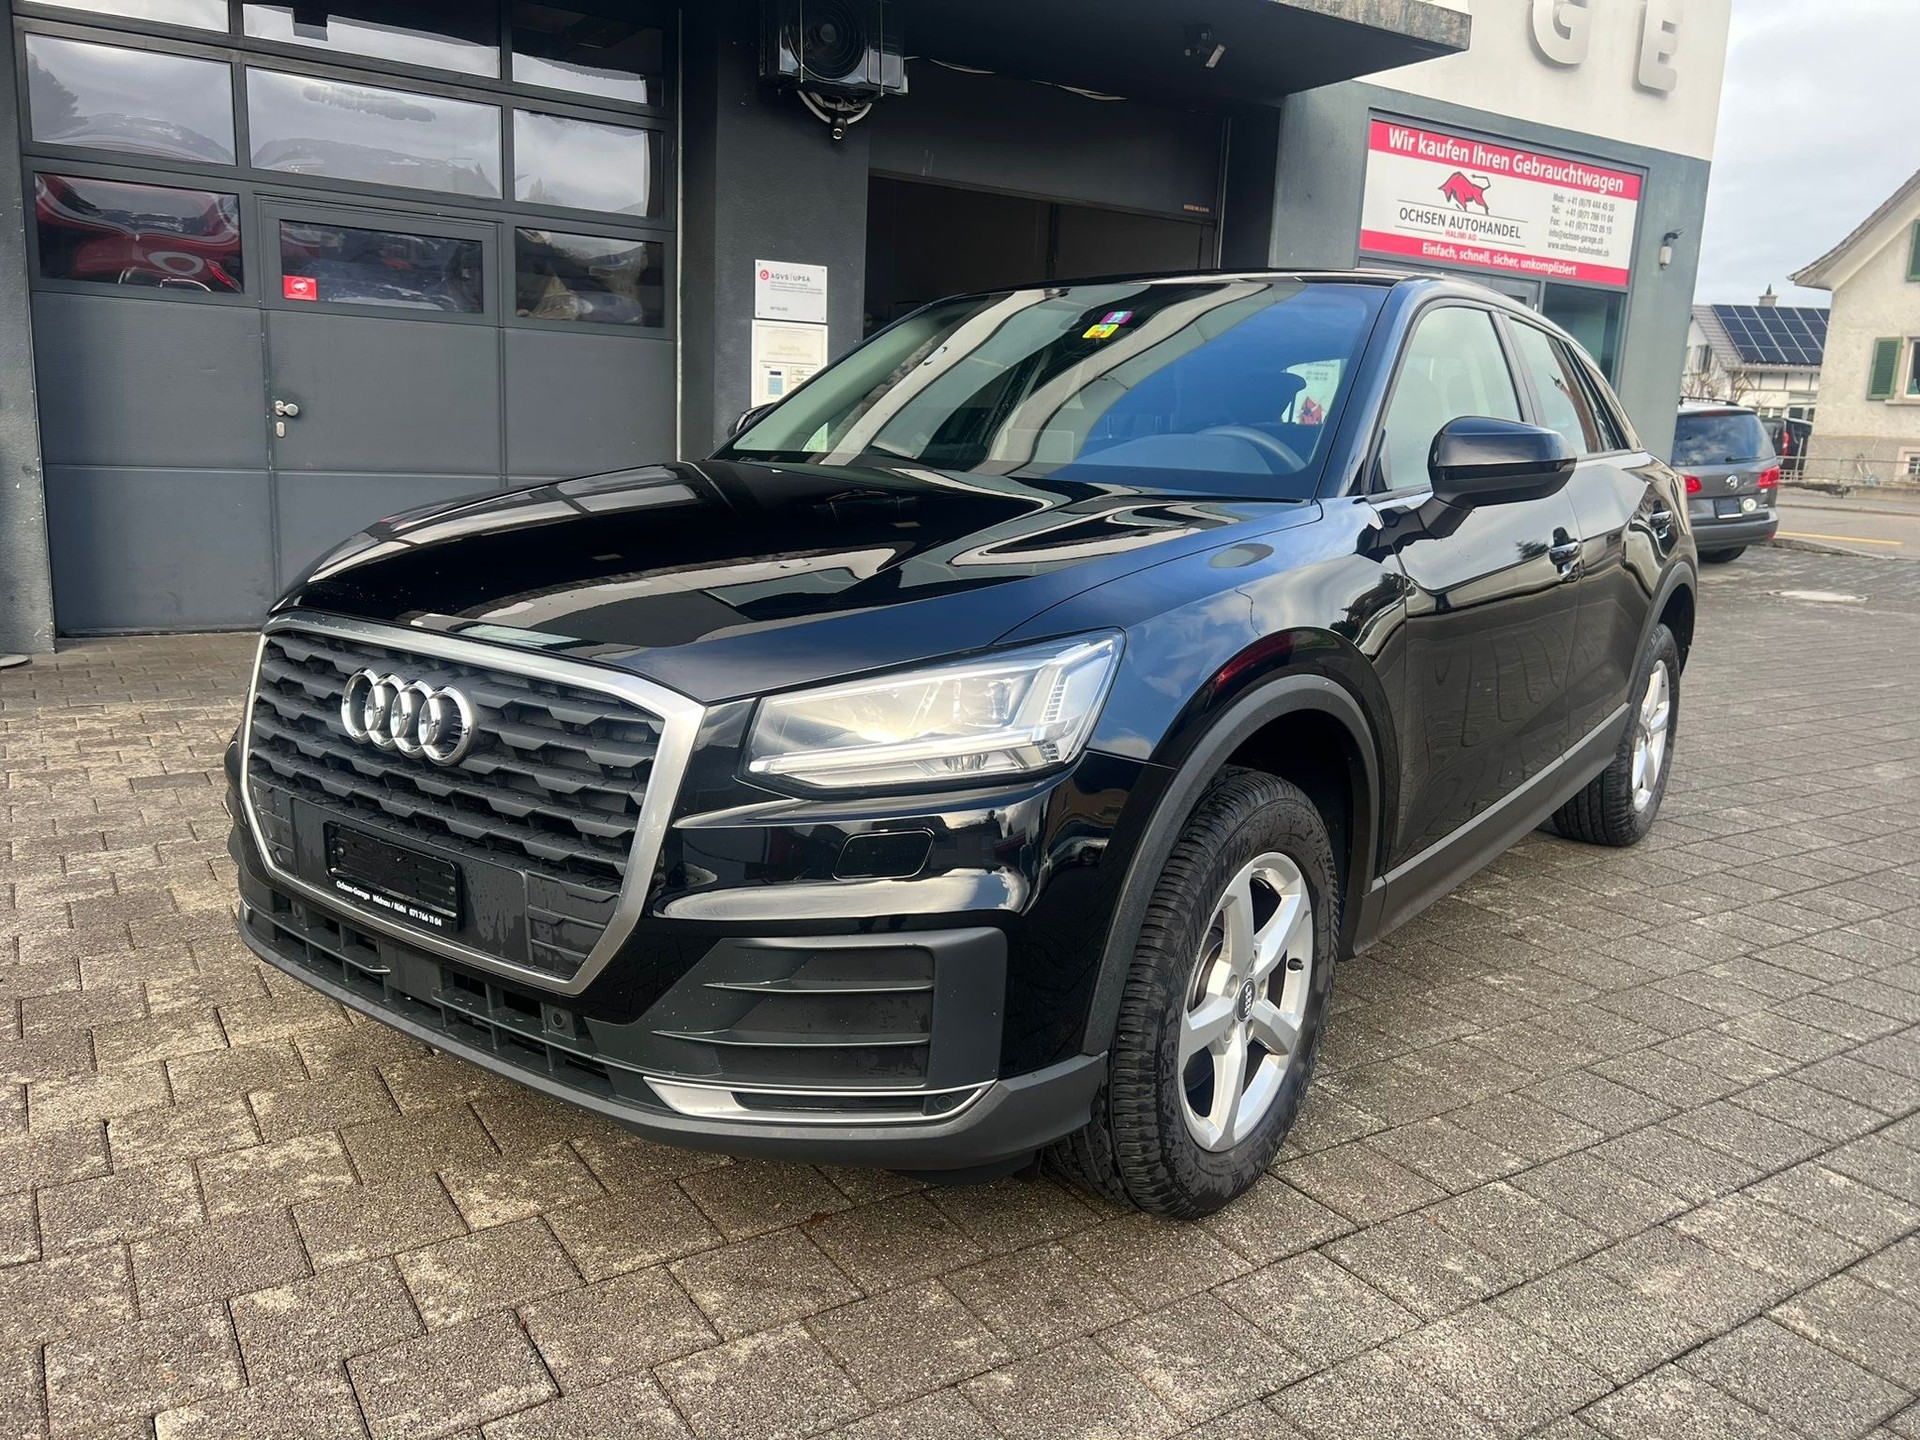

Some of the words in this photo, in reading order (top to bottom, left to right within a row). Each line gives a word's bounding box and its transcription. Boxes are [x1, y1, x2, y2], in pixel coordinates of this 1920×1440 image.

[1388, 127, 1415, 151] Wir
[1418, 133, 1469, 162] kaufen
[1472, 145, 1509, 171] Ihren
[1513, 154, 1624, 193] Gebrauchtwagen
[1399, 207, 1446, 227] OCHSEN
[1449, 216, 1521, 239] AUTOHANDEL
[1468, 233, 1478, 241] AG
[1422, 242, 1457, 259] Einfach,
[1459, 250, 1491, 265] schnell,
[1493, 254, 1519, 269] sicher,
[1520, 258, 1577, 276] unkompliziert
